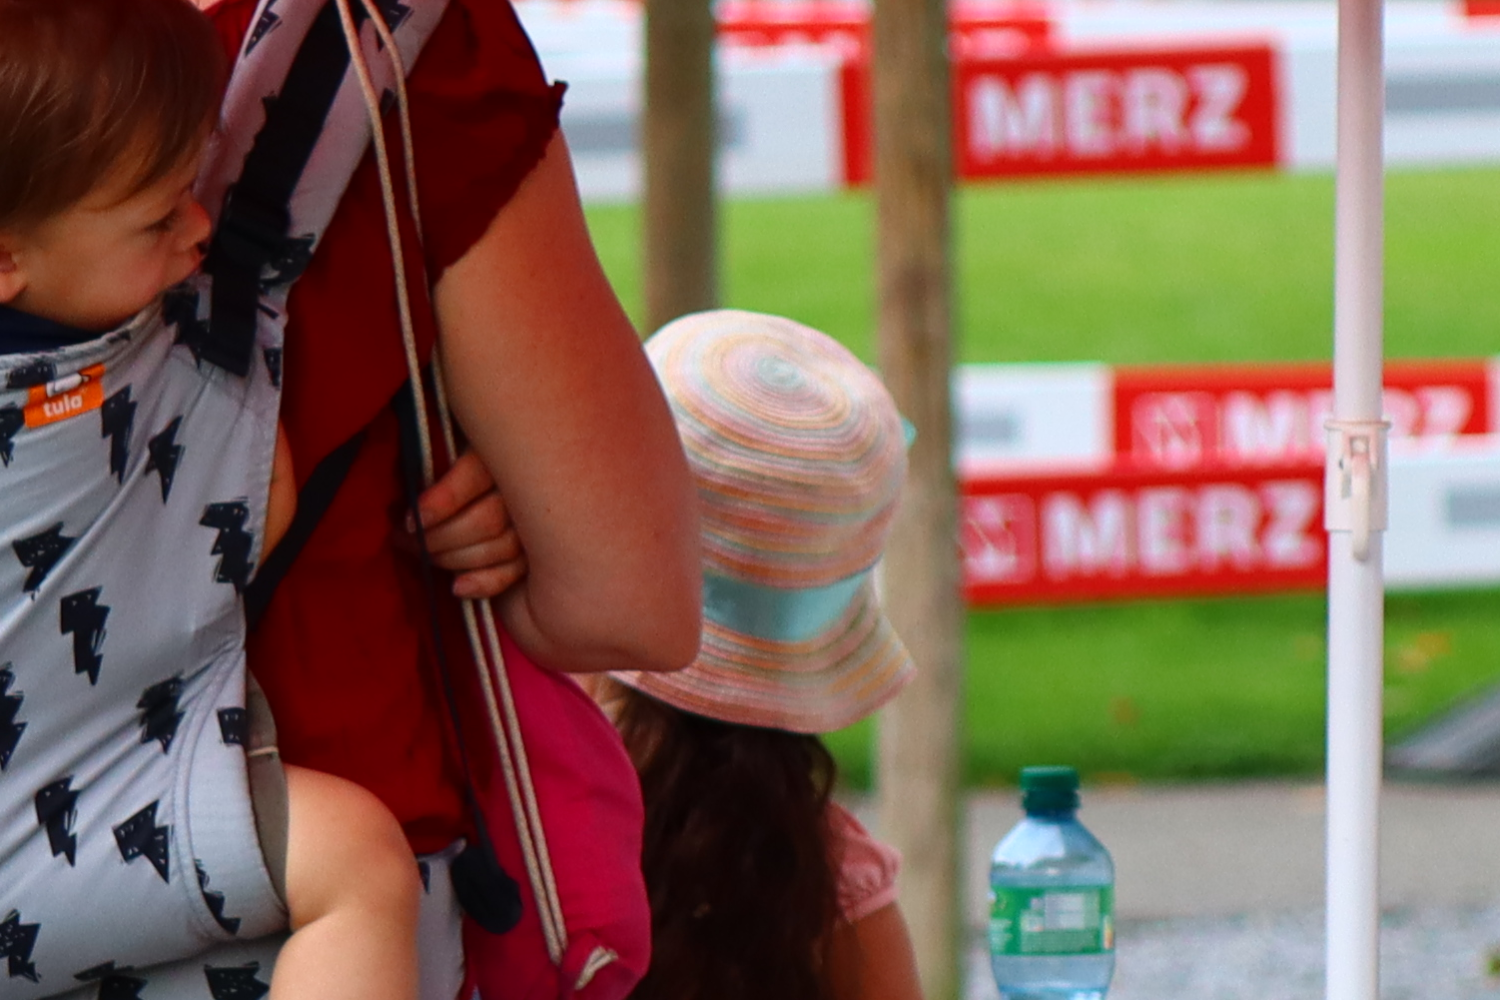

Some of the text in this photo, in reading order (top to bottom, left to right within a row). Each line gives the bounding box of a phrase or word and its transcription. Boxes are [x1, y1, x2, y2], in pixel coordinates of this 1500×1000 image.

[967, 65, 1249, 162] MERZ
[43, 393, 83, 418] tula
[1041, 480, 1322, 580] MERZ
